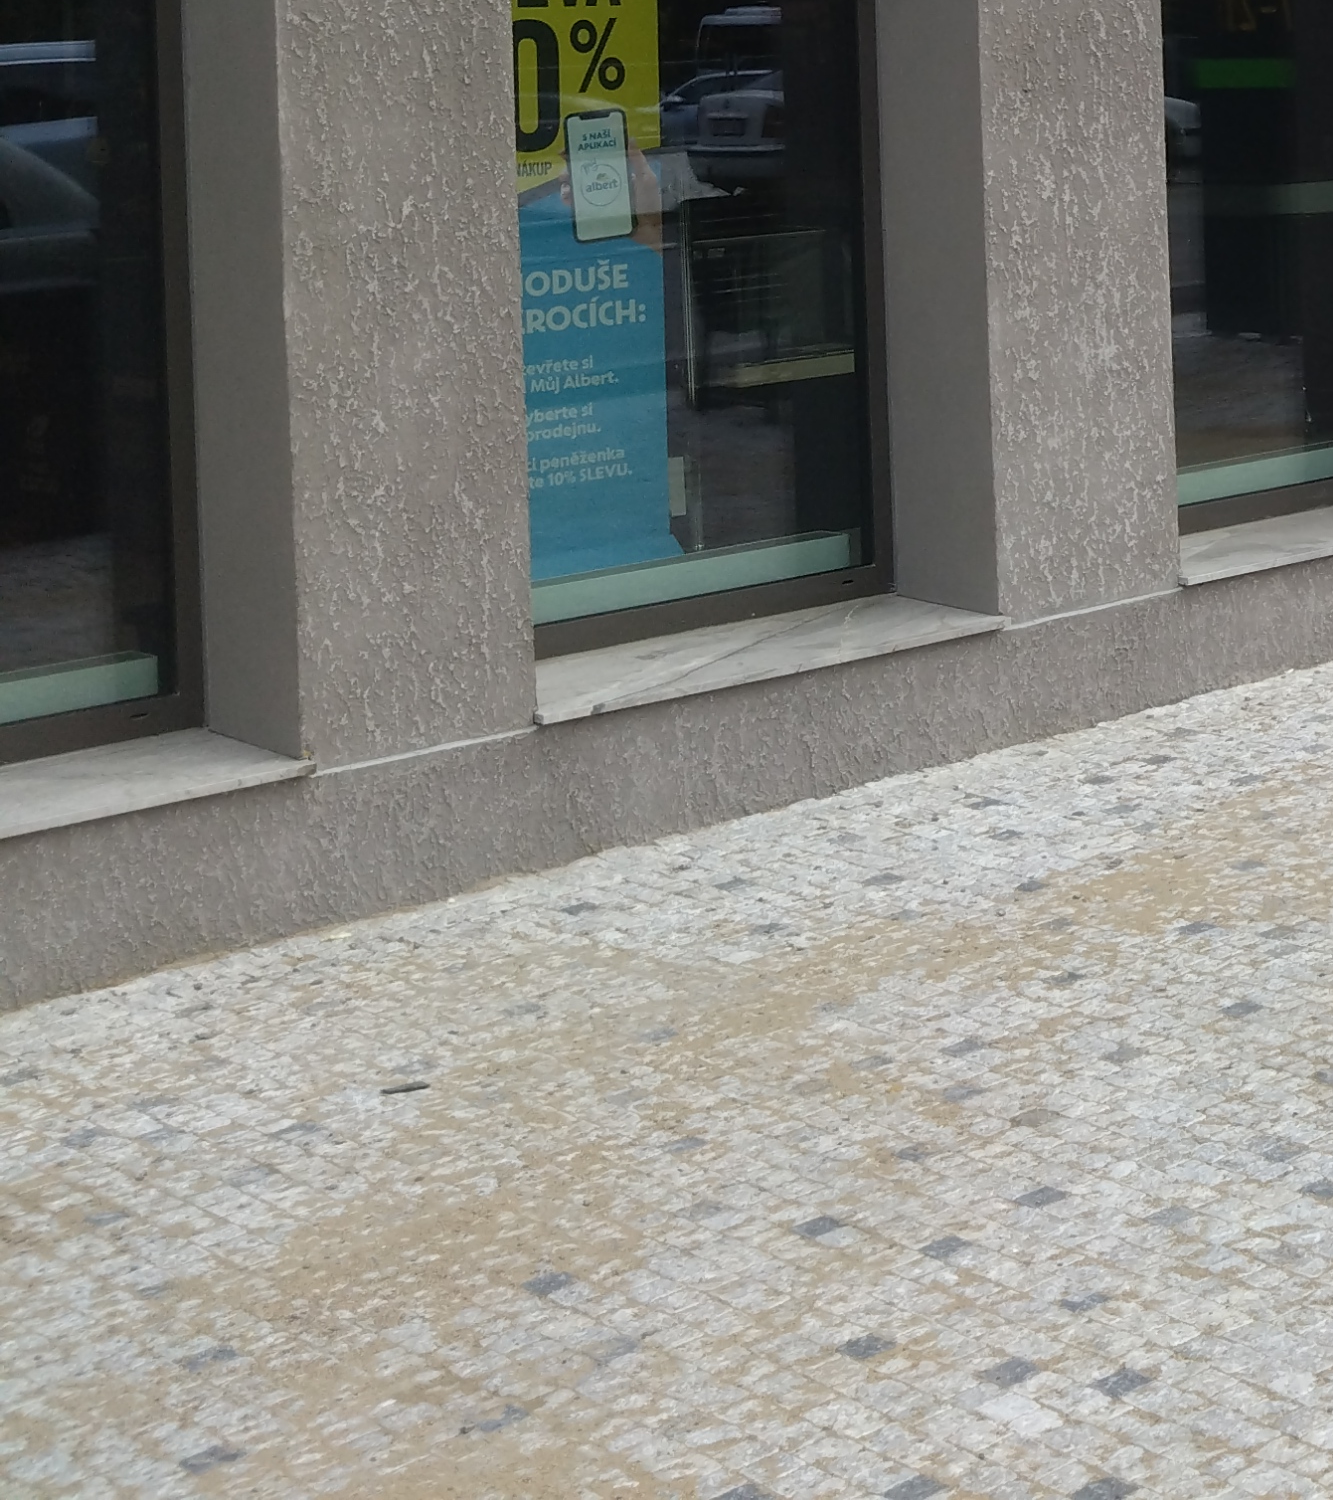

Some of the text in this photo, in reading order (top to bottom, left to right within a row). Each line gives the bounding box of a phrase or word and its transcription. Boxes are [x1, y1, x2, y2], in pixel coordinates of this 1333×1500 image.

[585, 178, 619, 193] albert
[520, 259, 629, 297] ODUŠE
[521, 296, 647, 335] ROCÍCH:
